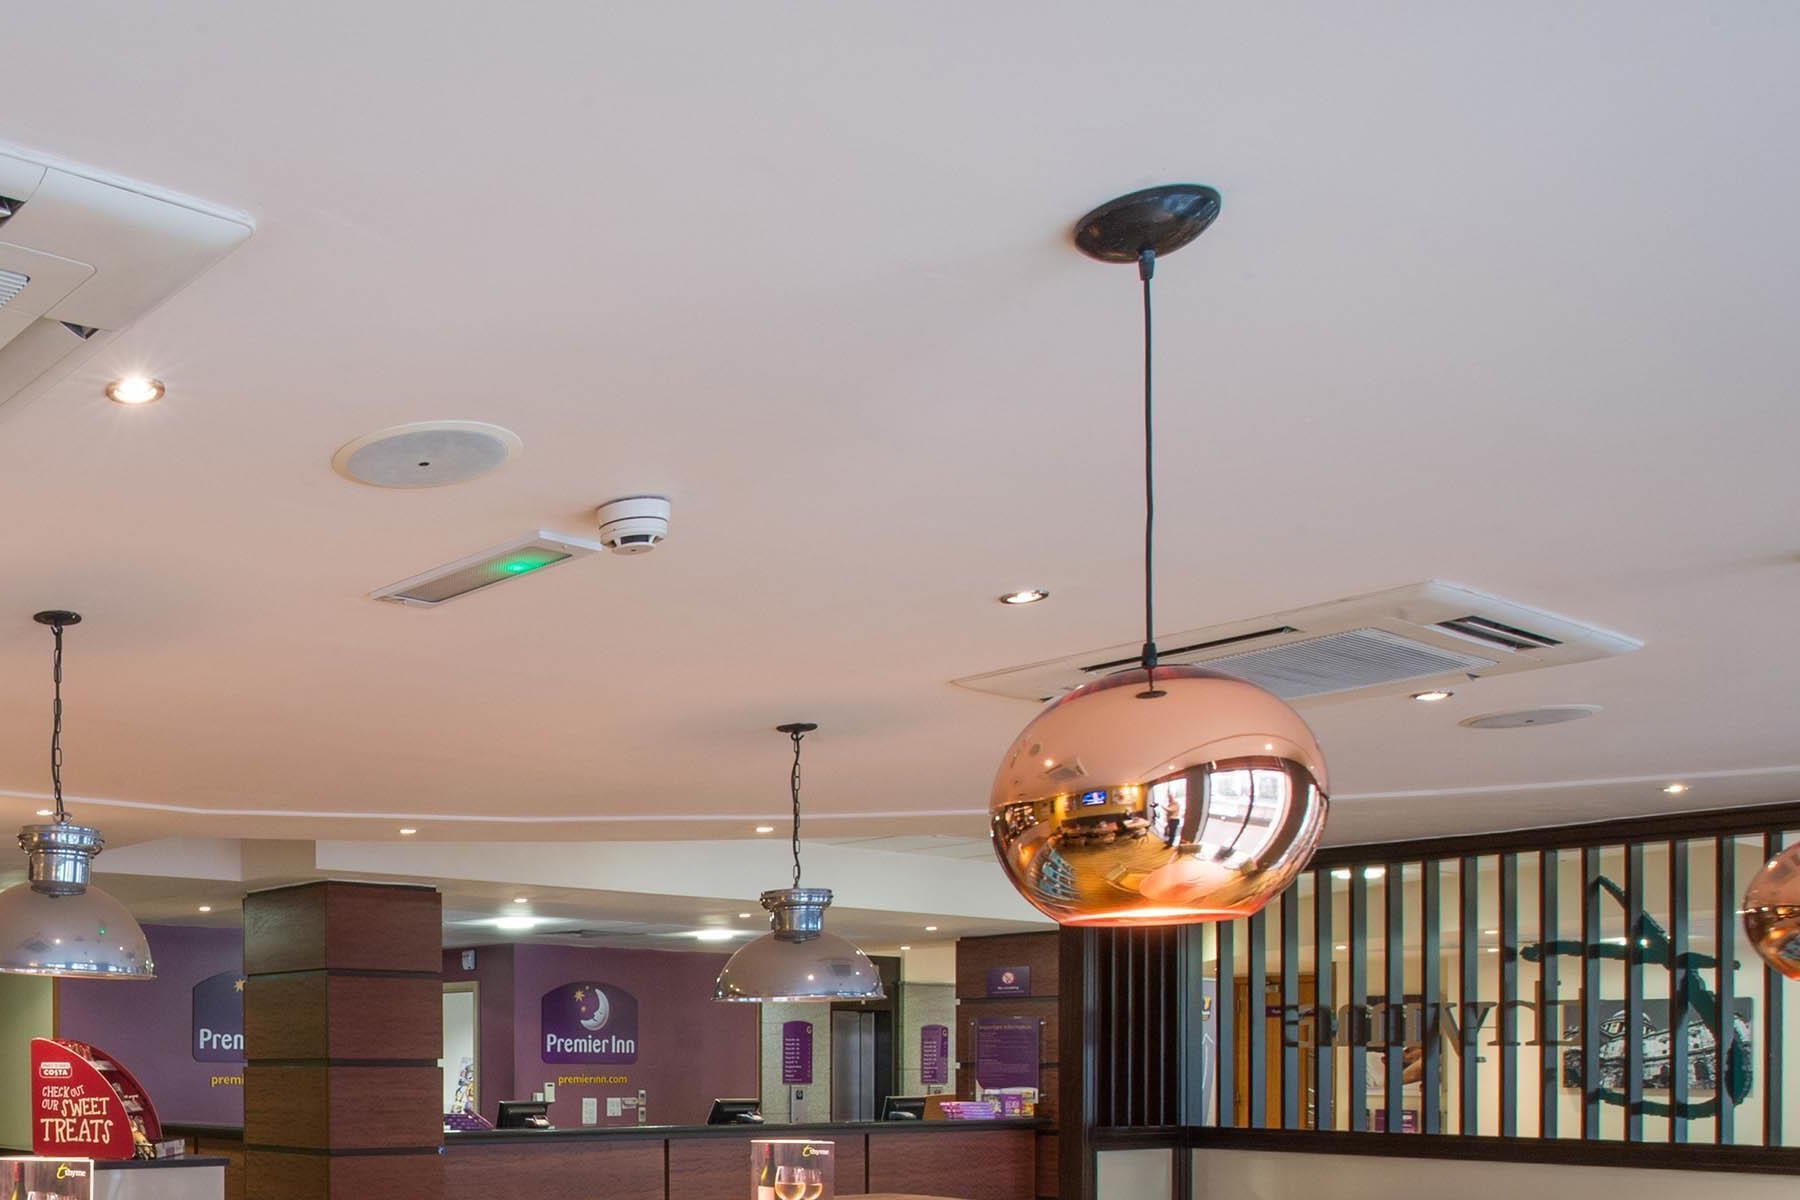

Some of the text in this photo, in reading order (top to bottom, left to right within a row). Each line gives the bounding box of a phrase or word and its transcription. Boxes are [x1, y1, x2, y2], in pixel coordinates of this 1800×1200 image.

[199, 1028, 244, 1050] Prem
[546, 1033, 635, 1054] Premier Inn
[211, 1073, 244, 1087] premi
[558, 1074, 628, 1087] premierinn.com
[42, 1084, 85, 1098] CHECK OUT
[41, 1097, 110, 1117] OUR SWEET
[40, 1118, 114, 1144] TREATS
